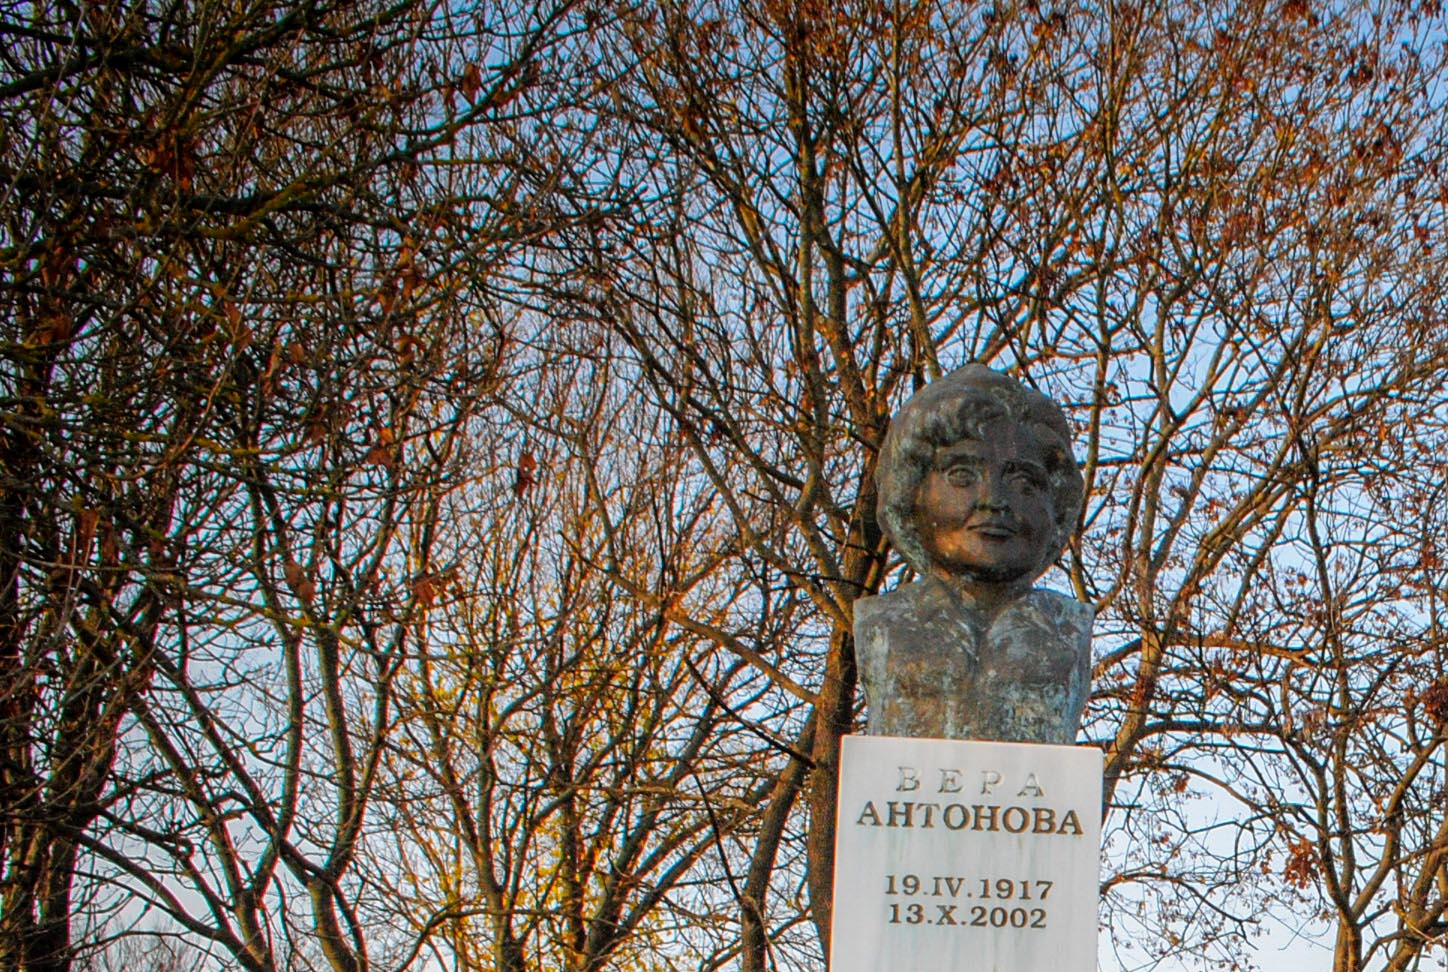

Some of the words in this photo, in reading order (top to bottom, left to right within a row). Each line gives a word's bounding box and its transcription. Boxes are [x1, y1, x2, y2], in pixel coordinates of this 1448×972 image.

[896, 767, 1044, 797] ВЕРА
[857, 801, 1084, 835] АНТОНОВА
[885, 874, 1053, 900] 19.IV.1917
[889, 903, 1047, 928] 13.X.2002
